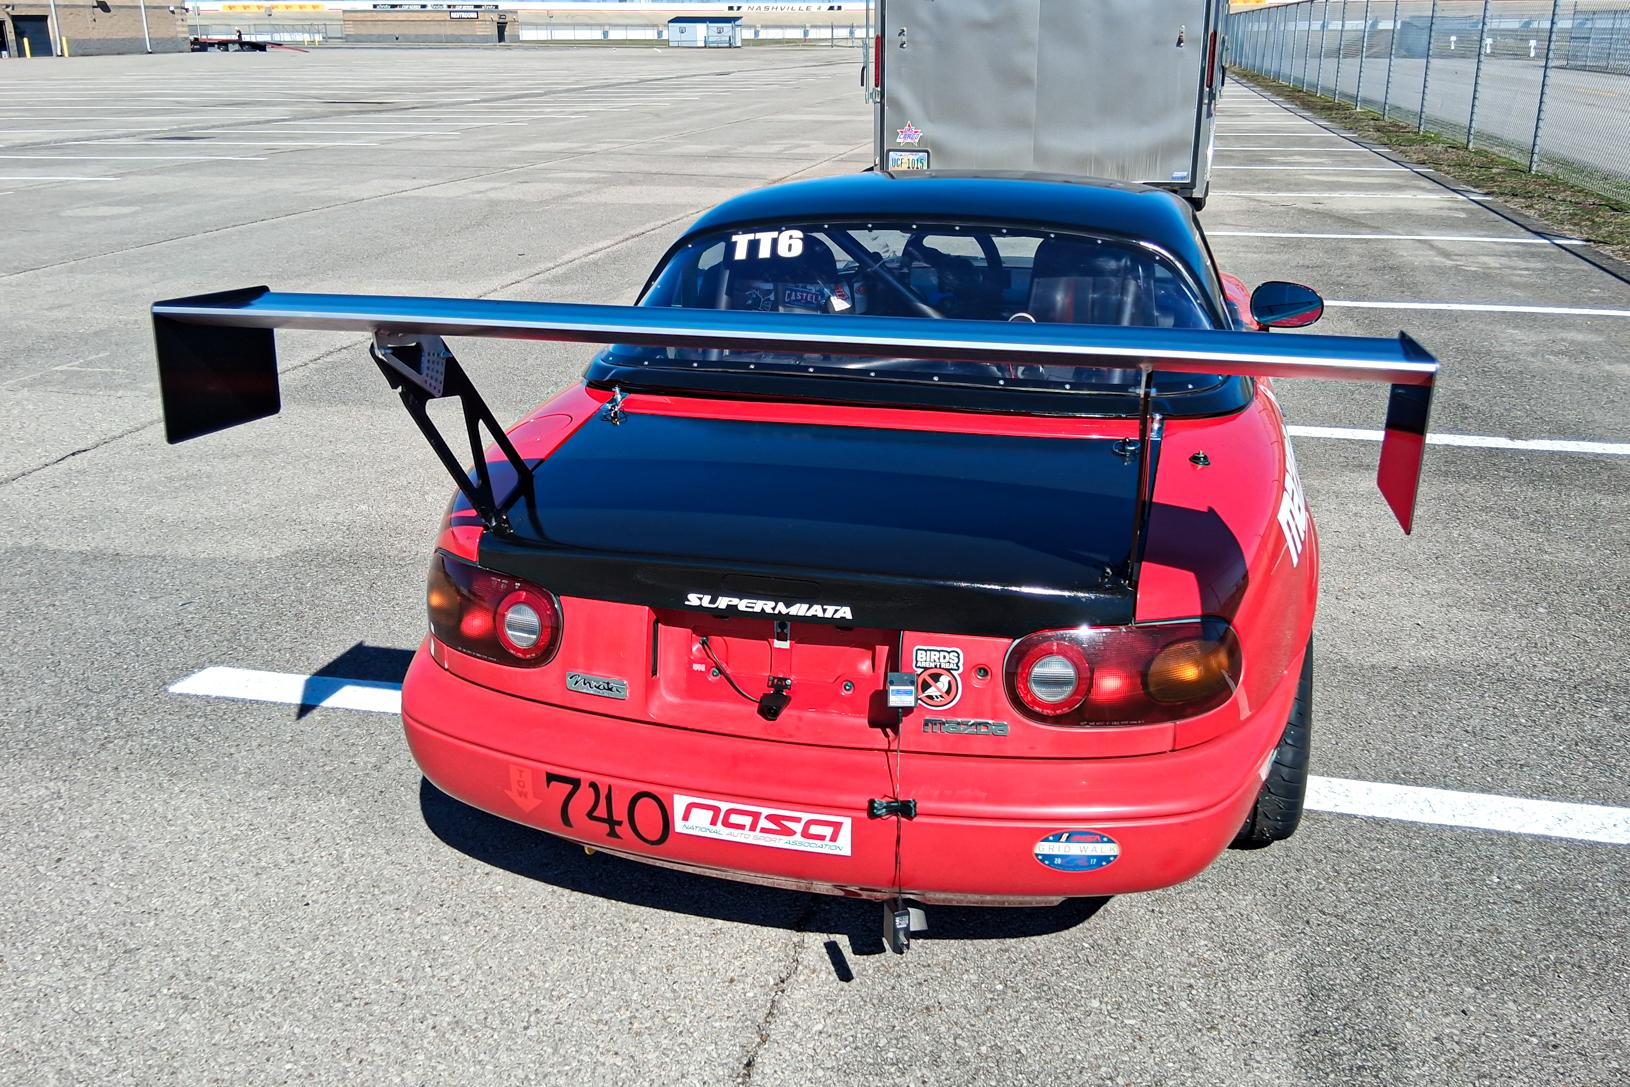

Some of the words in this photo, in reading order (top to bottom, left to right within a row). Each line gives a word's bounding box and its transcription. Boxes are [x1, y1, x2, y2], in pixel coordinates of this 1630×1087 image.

[732, 230, 804, 260] TT6
[685, 593, 853, 620] SUPERMIATA
[917, 650, 959, 664] BIRDS
[569, 674, 622, 694] Miata
[516, 769, 529, 800] TOW
[545, 771, 670, 846] 740
[682, 823, 724, 836] NATIONAL
[726, 830, 751, 840] AUTO
[752, 834, 783, 844] SPORT
[784, 839, 844, 852] ASSOCIATION
[1038, 844, 1071, 853] GRID
[1080, 845, 1117, 854] WALK
